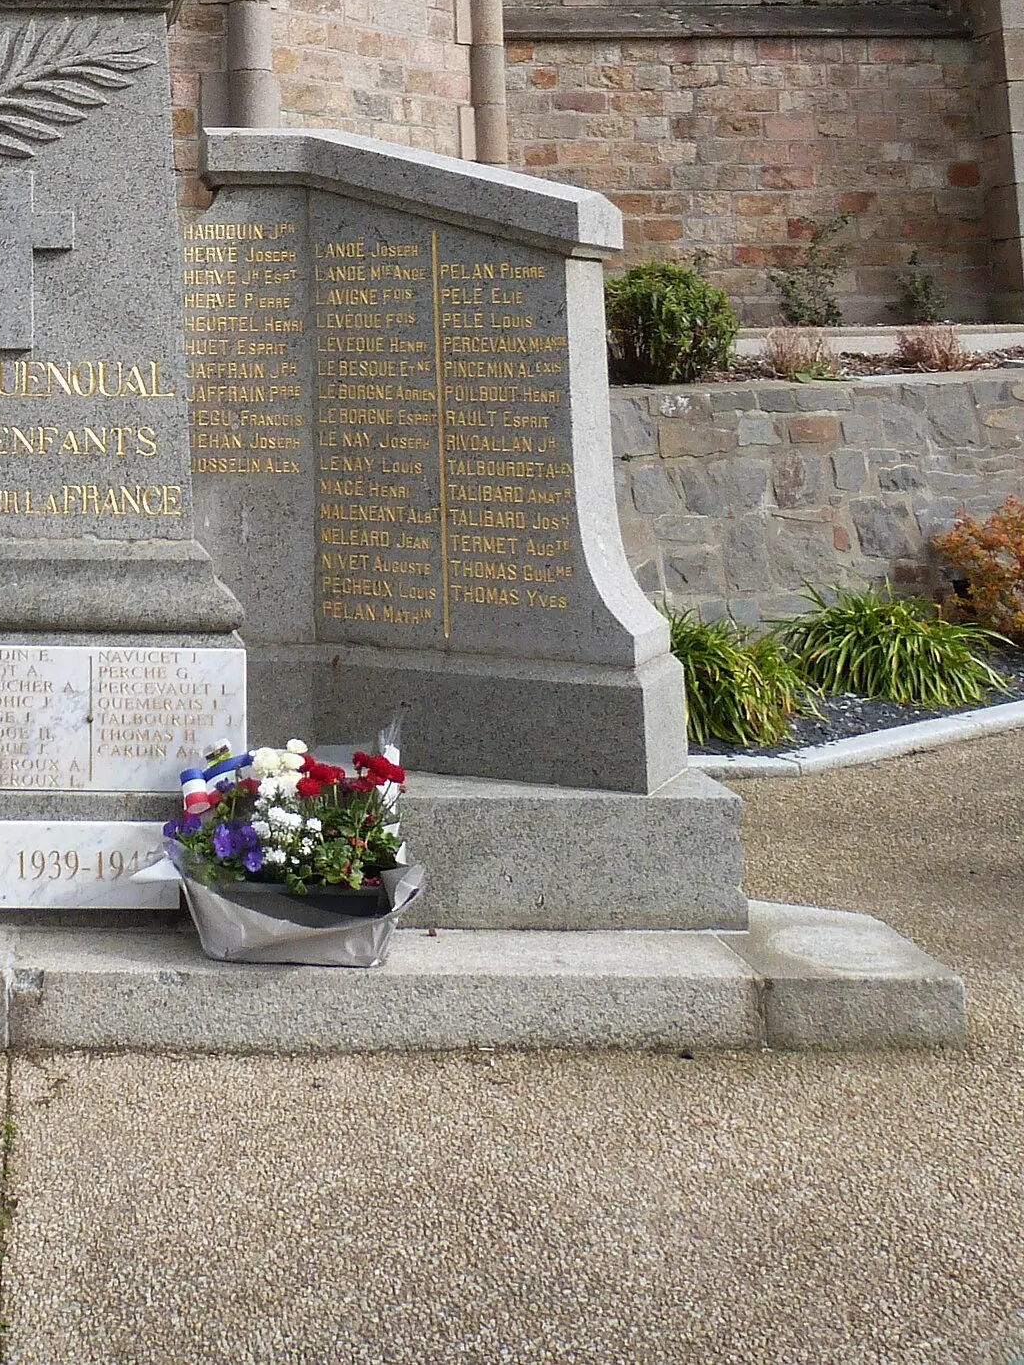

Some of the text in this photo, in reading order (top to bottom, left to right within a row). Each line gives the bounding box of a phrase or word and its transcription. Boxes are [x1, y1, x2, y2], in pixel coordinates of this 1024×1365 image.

[184, 224, 263, 239] HARDOUIN
[184, 242, 237, 263] HERVÉ
[316, 289, 377, 305] LAVIGNE
[184, 317, 258, 332] HEURTEL
[185, 340, 228, 355] HUET
[444, 337, 527, 353] PERCEVAUX
[186, 363, 264, 379] JAFFRAIN
[318, 361, 335, 376] LE
[444, 362, 513, 378] PINCEMIN
[187, 386, 264, 402] JAFFRAIN
[319, 385, 336, 399] LE
[339, 385, 393, 400] BORGNE
[445, 386, 518, 402] POILBOUT
[319, 409, 336, 423] LE
[340, 409, 393, 425] BORGNE
[446, 411, 497, 427] RAULT
[320, 431, 337, 446] LE
[343, 432, 372, 447] NAY
[447, 435, 532, 453] RIVOALLAN
[320, 457, 338, 471] LE
[343, 457, 374, 472] NAY
[448, 460, 544, 478] TALBOURDET
[320, 475, 364, 496] MACÉ
[26, 492, 58, 515] LA
[62, 485, 182, 516] FRANCE
[449, 485, 523, 503] TALIBARD
[449, 509, 525, 529] TALIBARD
[450, 535, 518, 554] TERMET
[322, 554, 369, 570] NIVET
[450, 560, 517, 581] THOMAS
[451, 585, 519, 606] THOMAS
[98, 651, 183, 663] NAVUCET
[99, 666, 167, 679] PERCHE
[98, 682, 212, 696] PERCEVAULT
[98, 714, 215, 727] TALBOURDET
[98, 728, 173, 742] THOMAS
[98, 744, 167, 757] CARDIN
